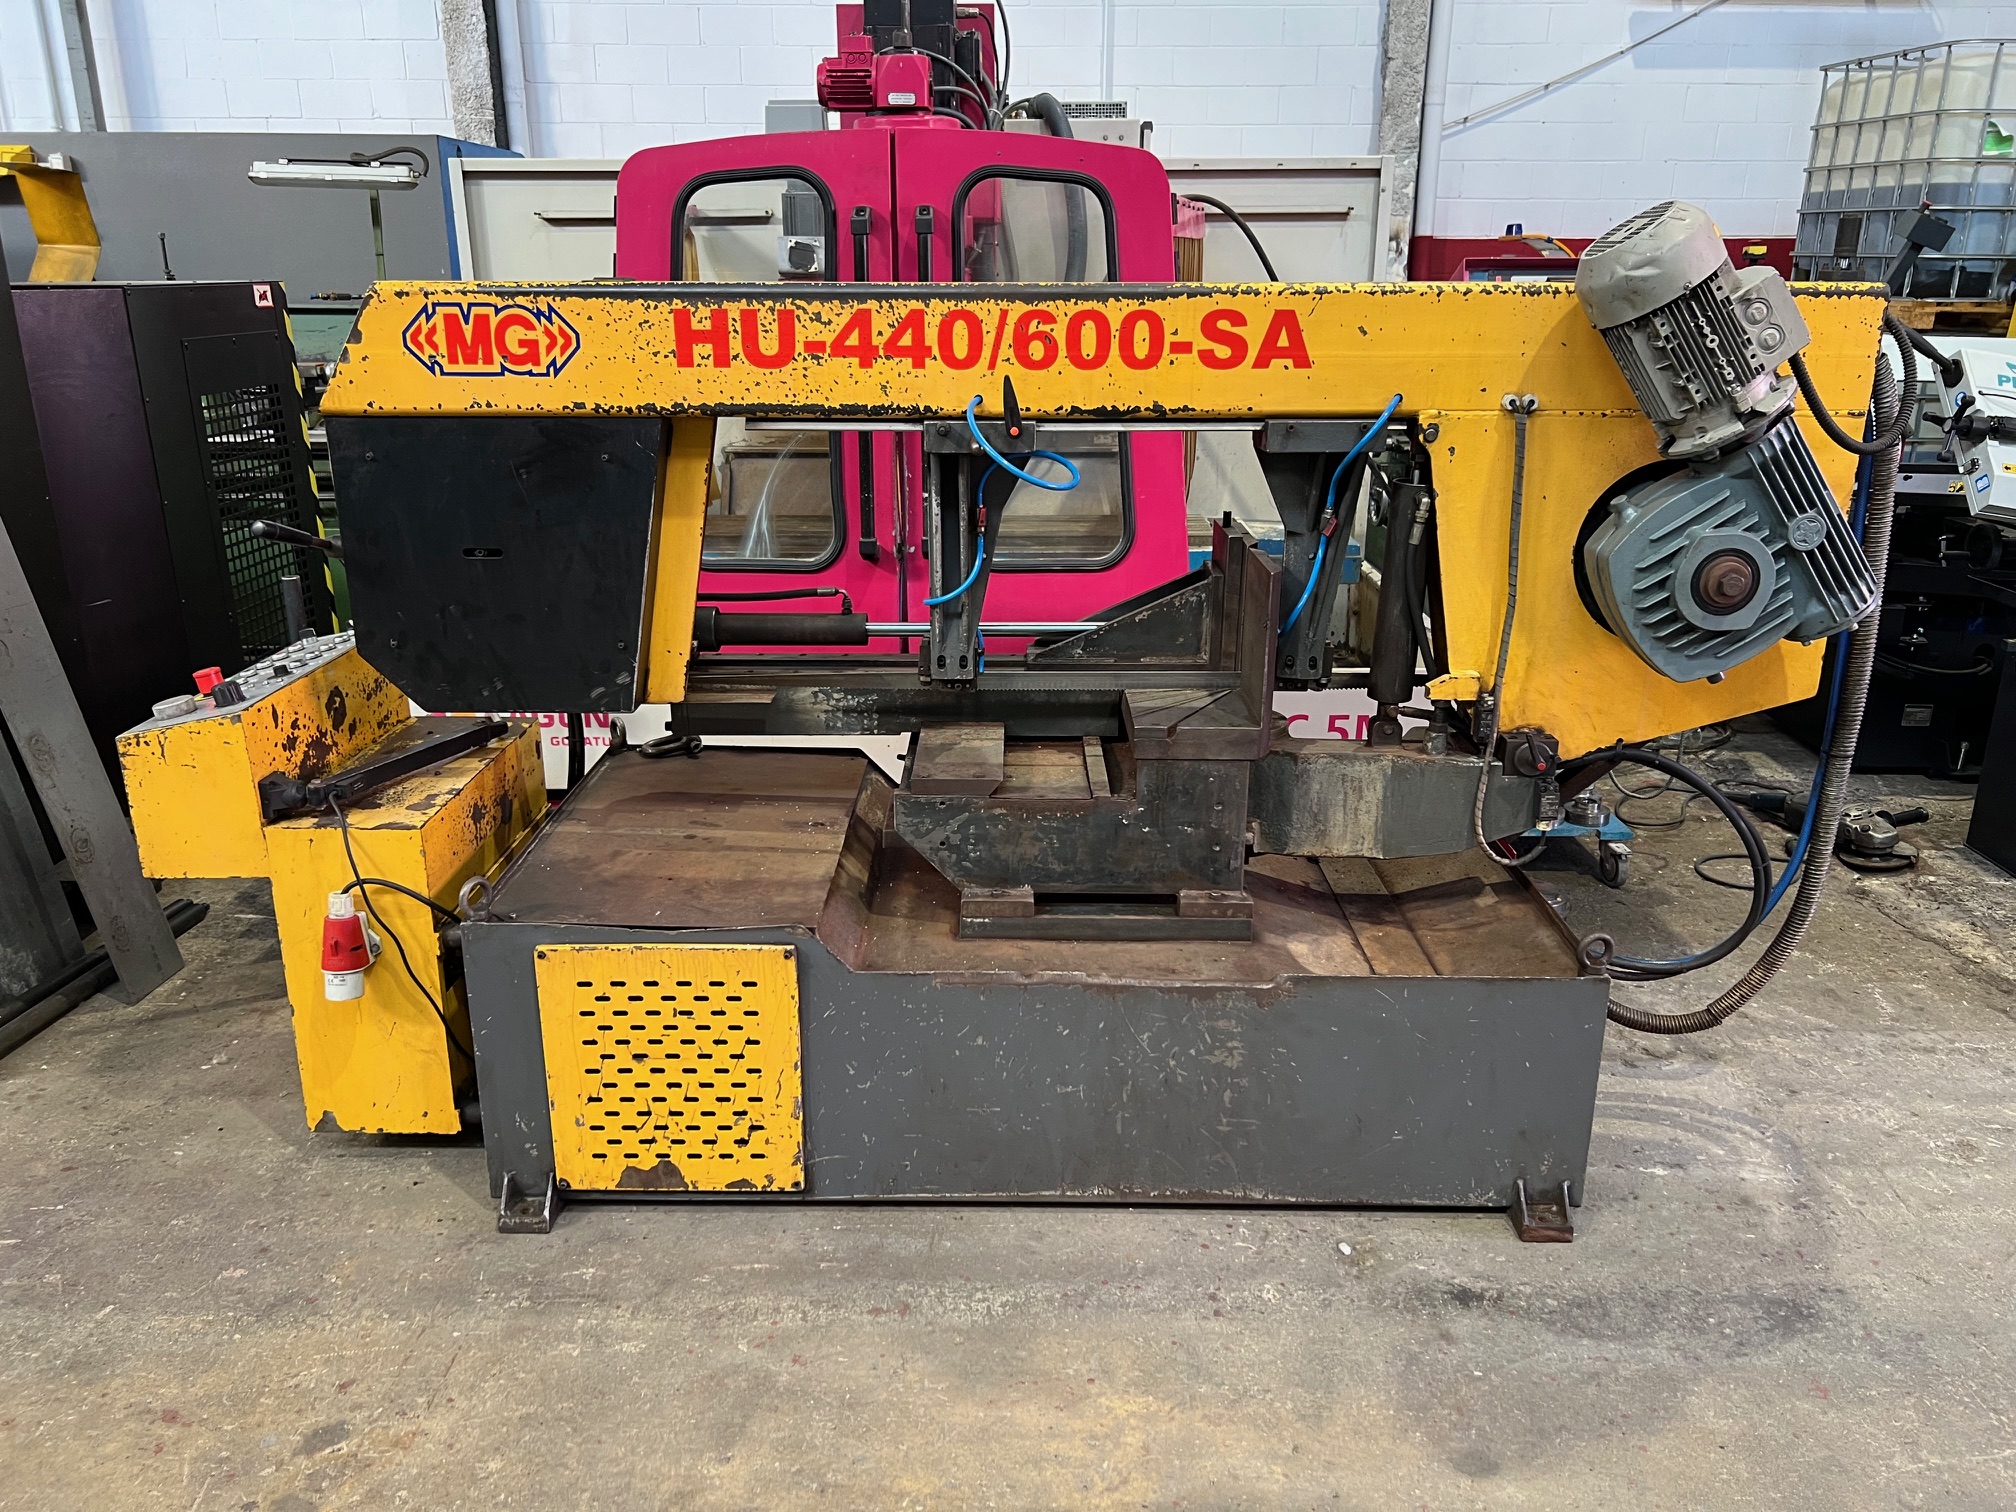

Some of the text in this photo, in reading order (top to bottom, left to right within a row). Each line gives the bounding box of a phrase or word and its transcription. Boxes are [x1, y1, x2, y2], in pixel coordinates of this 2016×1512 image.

[443, 314, 541, 366] MG
[673, 308, 1313, 371] HU-440/600-SA
[550, 736, 611, 747] GOATU
